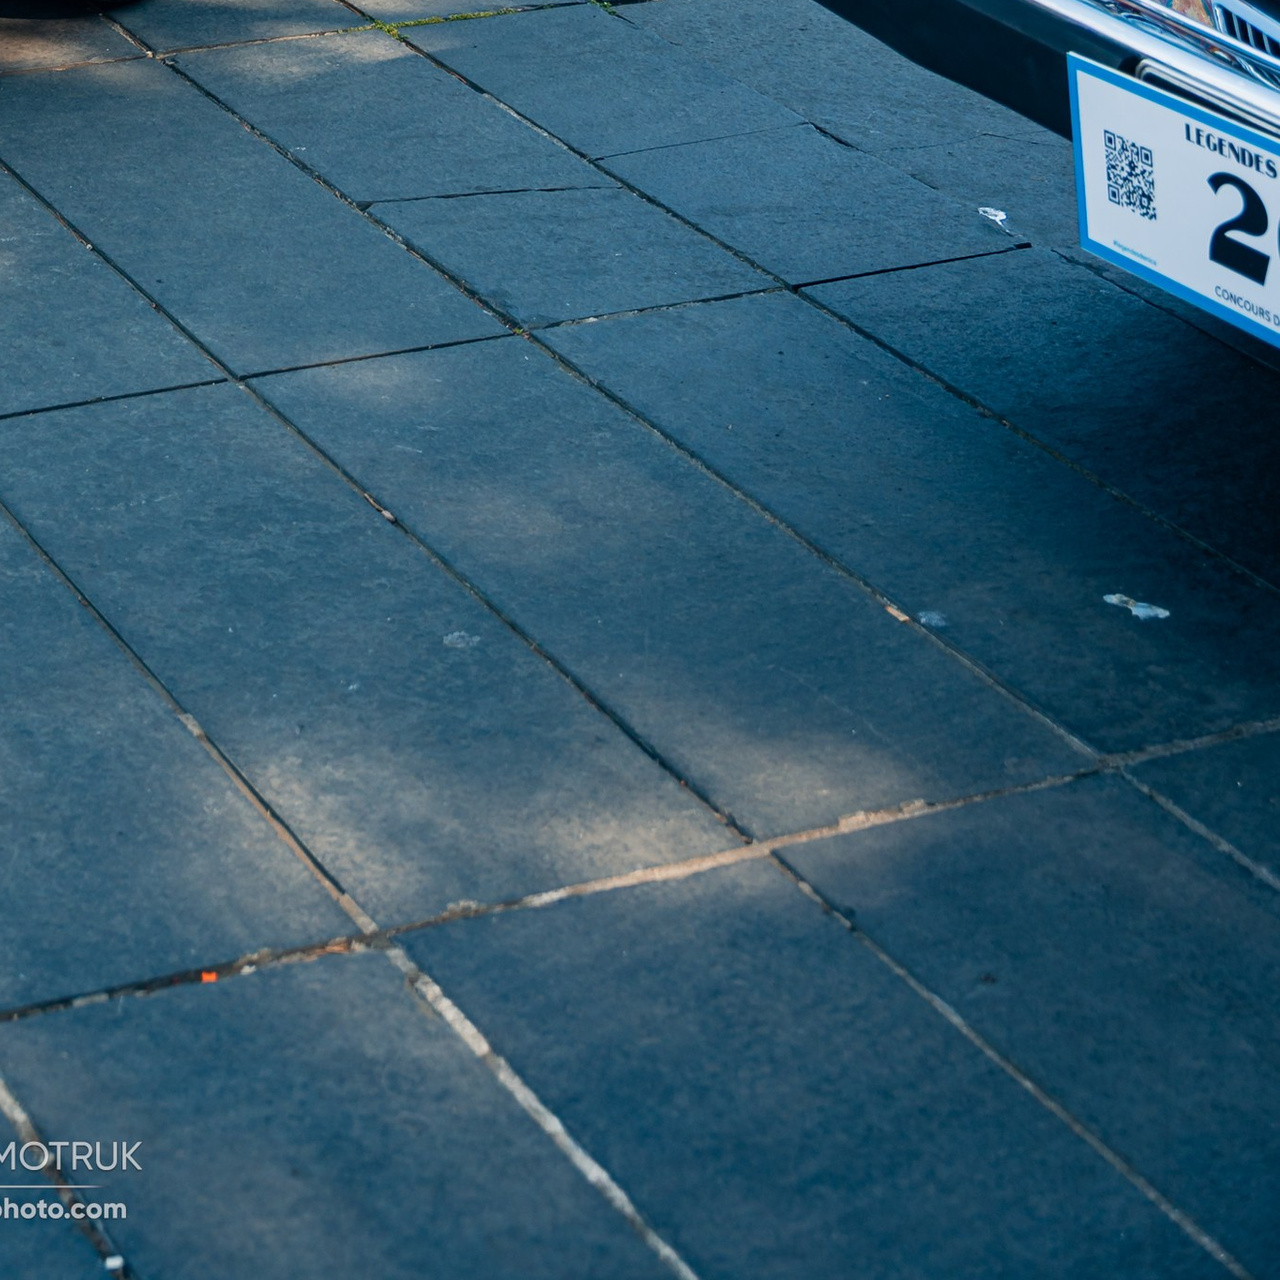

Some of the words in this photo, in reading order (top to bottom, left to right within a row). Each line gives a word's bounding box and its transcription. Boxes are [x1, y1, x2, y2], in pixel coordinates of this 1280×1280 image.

[1184, 121, 1278, 180] LEGENDES
[1206, 170, 1280, 287] 2
[1214, 284, 1271, 323] CONCOURS
